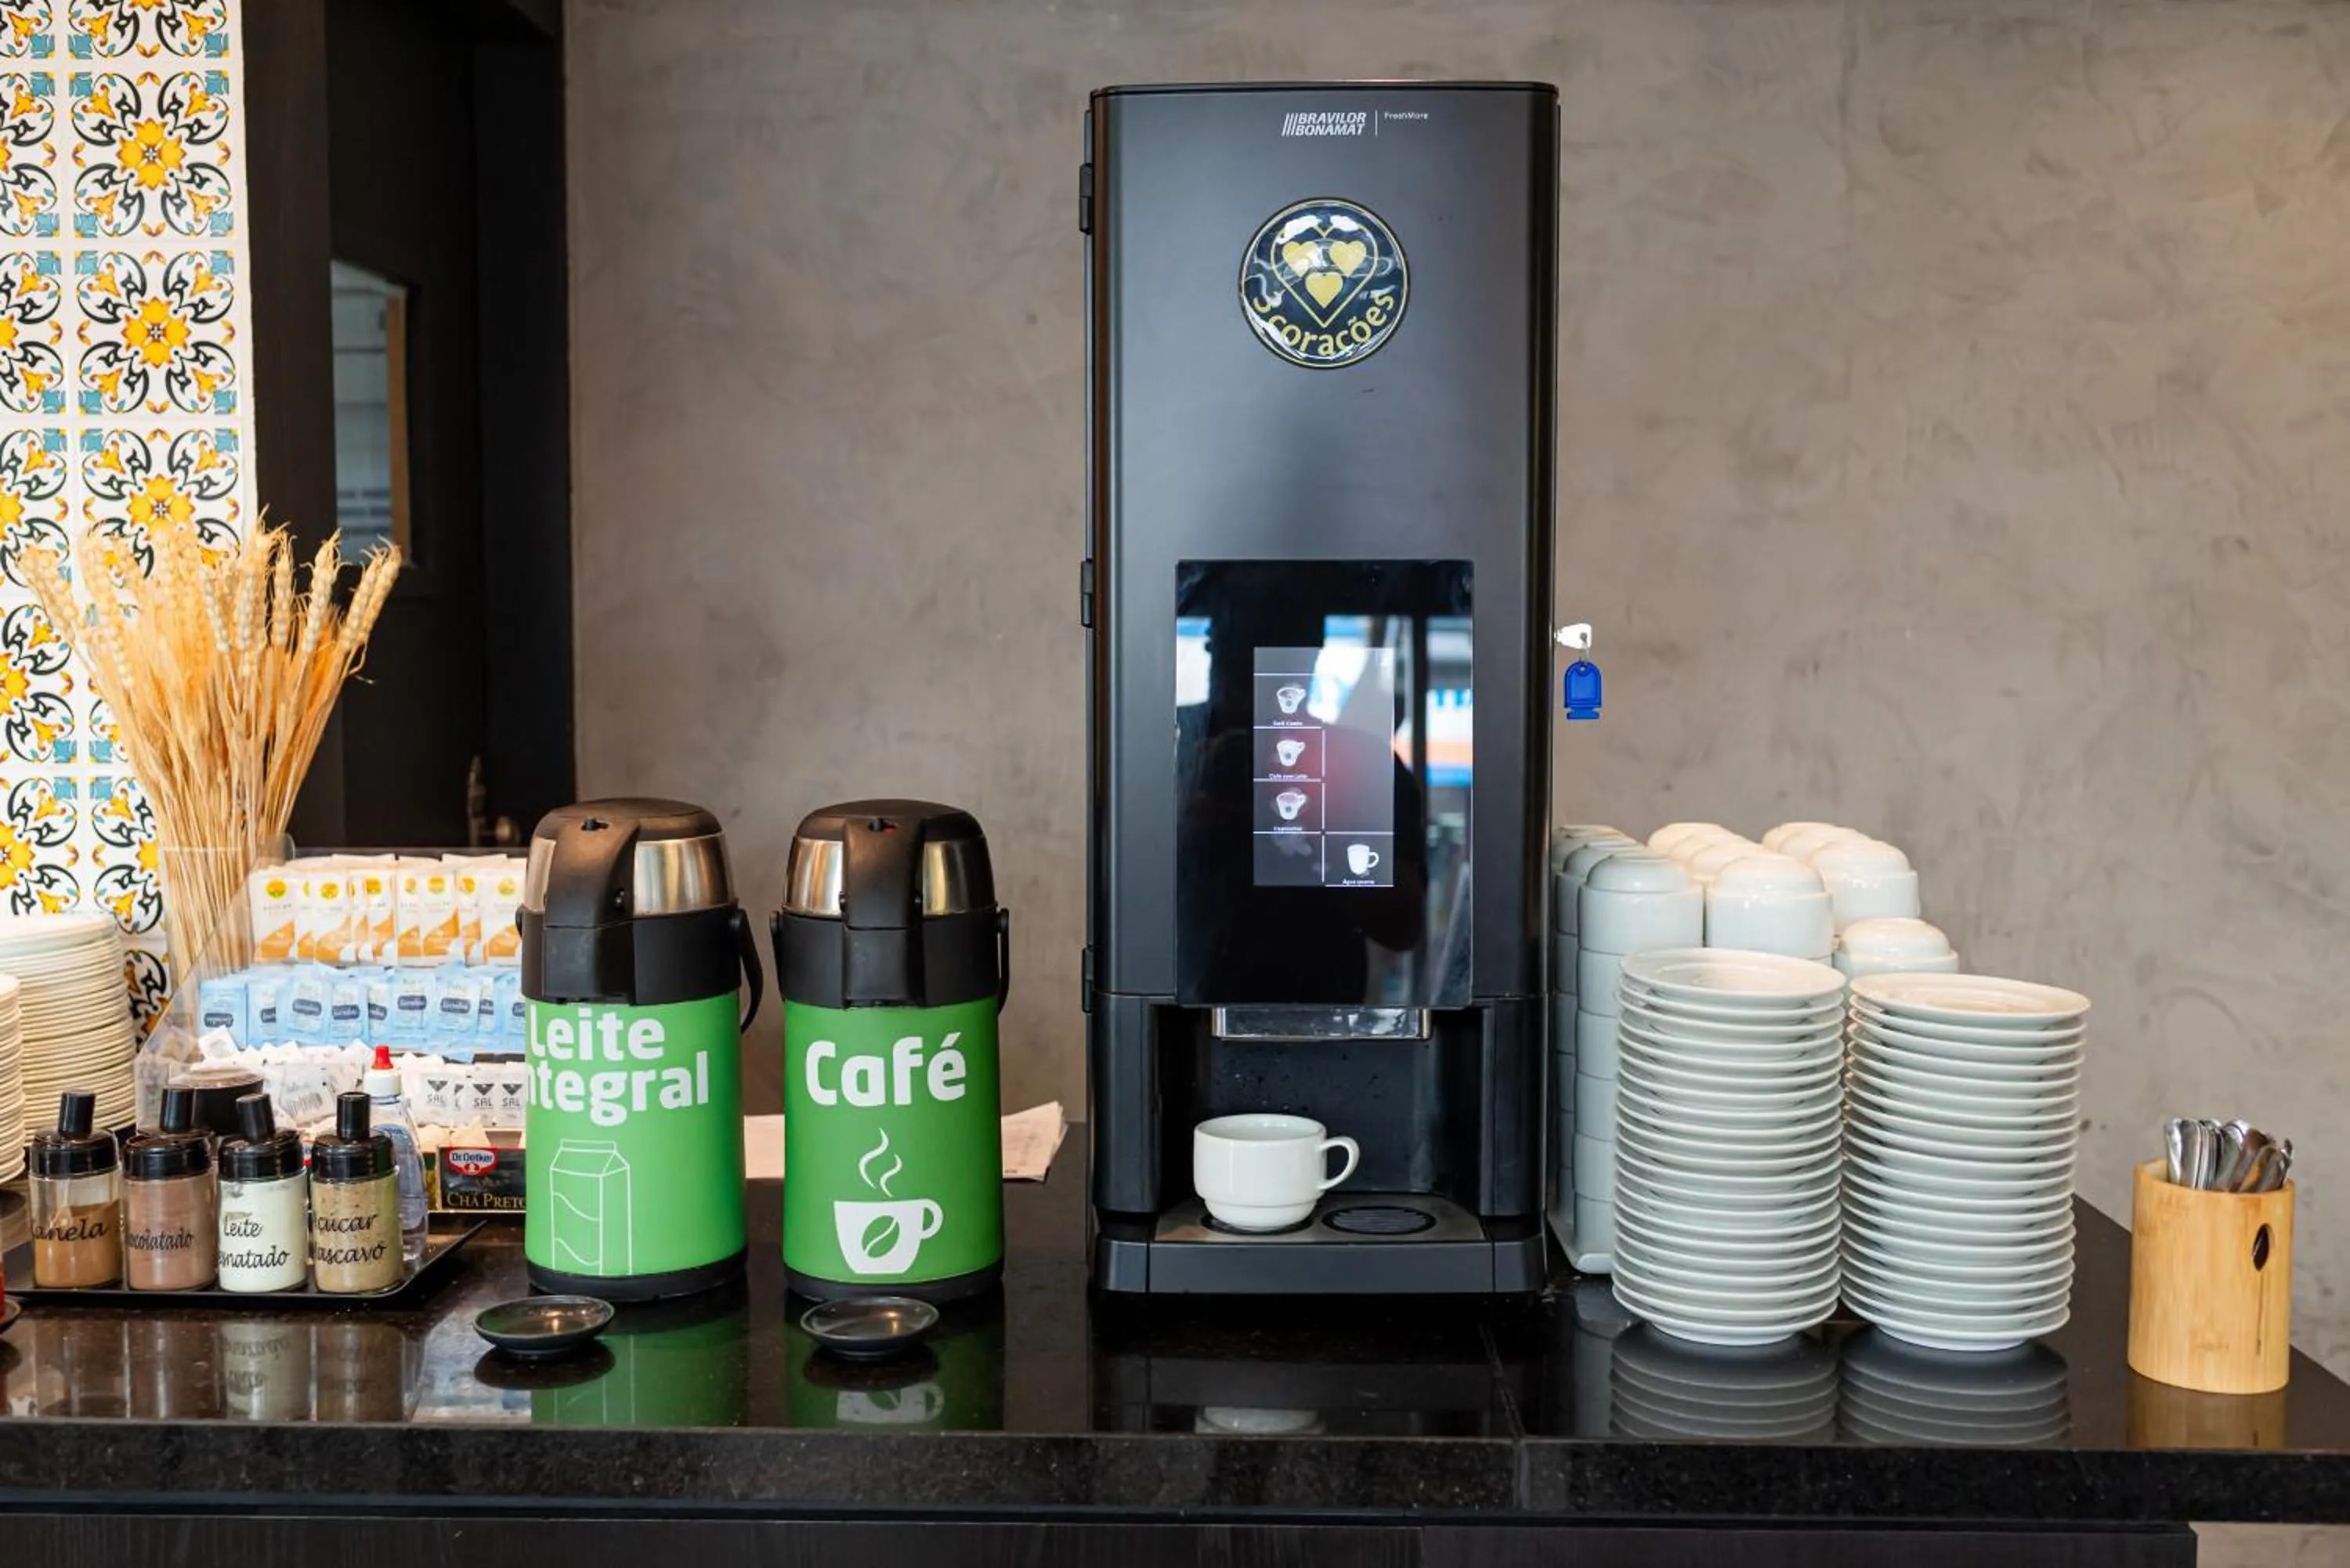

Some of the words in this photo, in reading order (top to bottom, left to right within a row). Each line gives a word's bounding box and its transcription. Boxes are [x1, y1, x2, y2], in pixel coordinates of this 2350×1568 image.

[1298, 112, 1367, 124] BRAVILOR
[1296, 124, 1365, 135] BONAMAT
[805, 1031, 967, 1107] Café
[526, 1050, 709, 1126] ntegral
[474, 1097, 494, 1107] SAL
[501, 1097, 520, 1107] SAL
[32, 1218, 108, 1241] anela
[314, 1241, 387, 1265] ascavo
